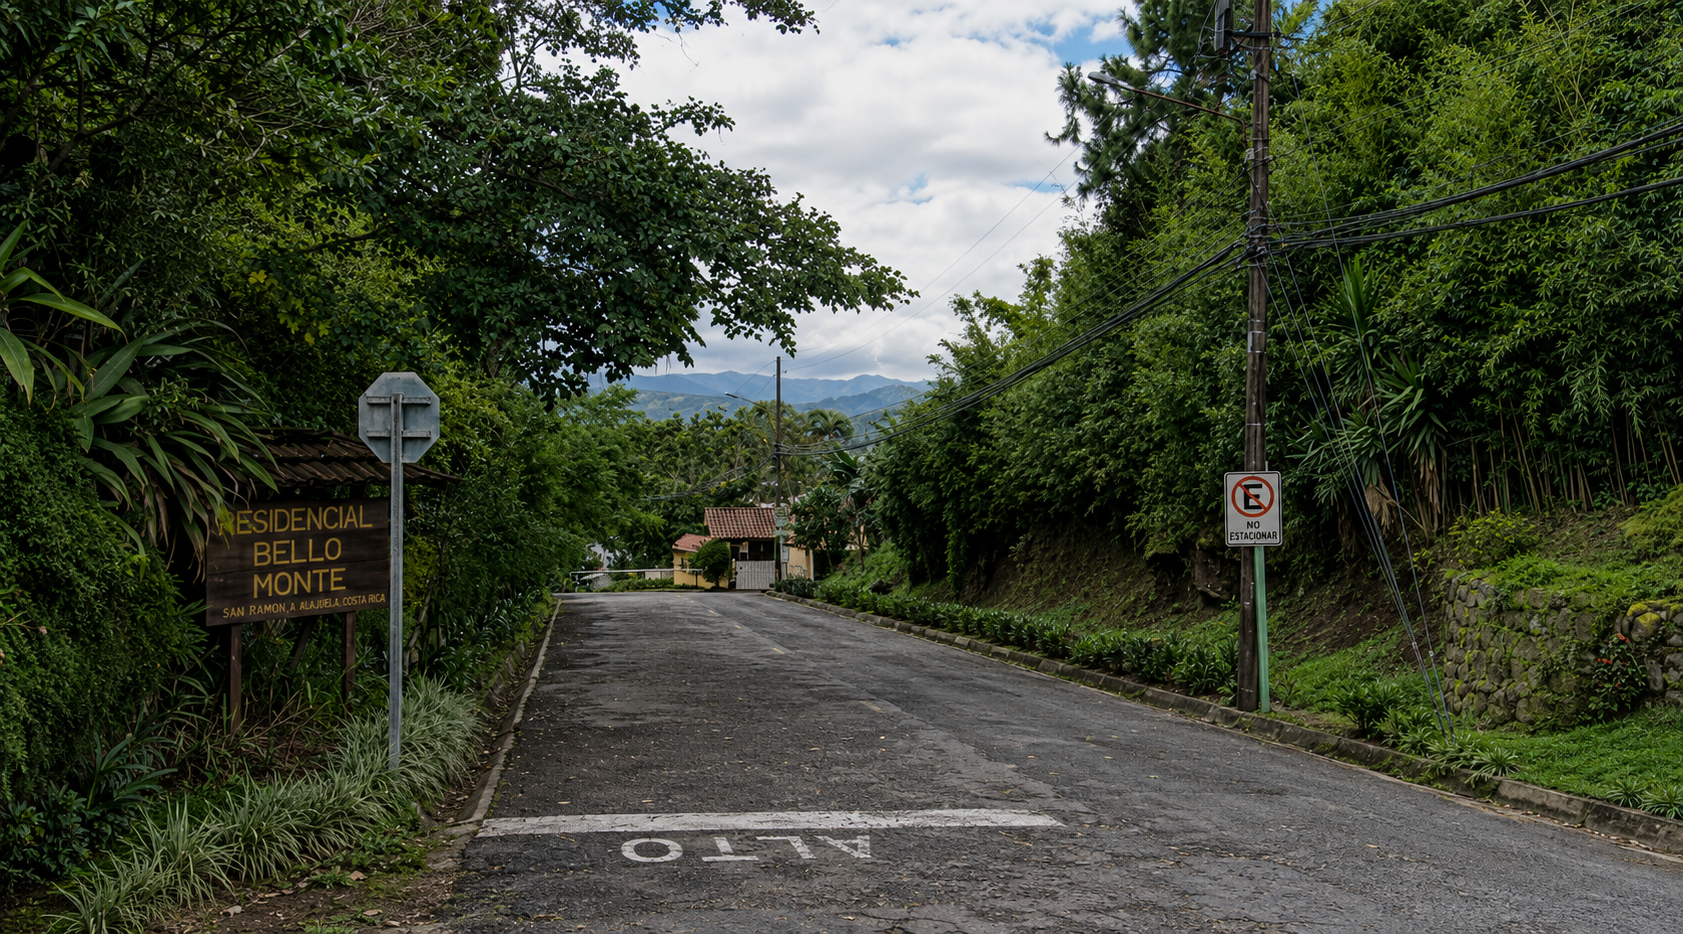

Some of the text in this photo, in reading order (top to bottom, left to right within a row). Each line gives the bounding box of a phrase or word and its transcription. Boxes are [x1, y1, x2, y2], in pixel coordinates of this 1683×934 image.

[1243, 483, 1263, 509] E
[1230, 531, 1278, 540] ESTACIONAR
[1246, 521, 1260, 529] NO
[254, 538, 342, 567] BELLO
[253, 568, 346, 598] MONTE
[223, 607, 245, 619] SAN
[342, 595, 367, 606] COSTA
[368, 593, 386, 603] RICA
[620, 835, 872, 862] ALTO
